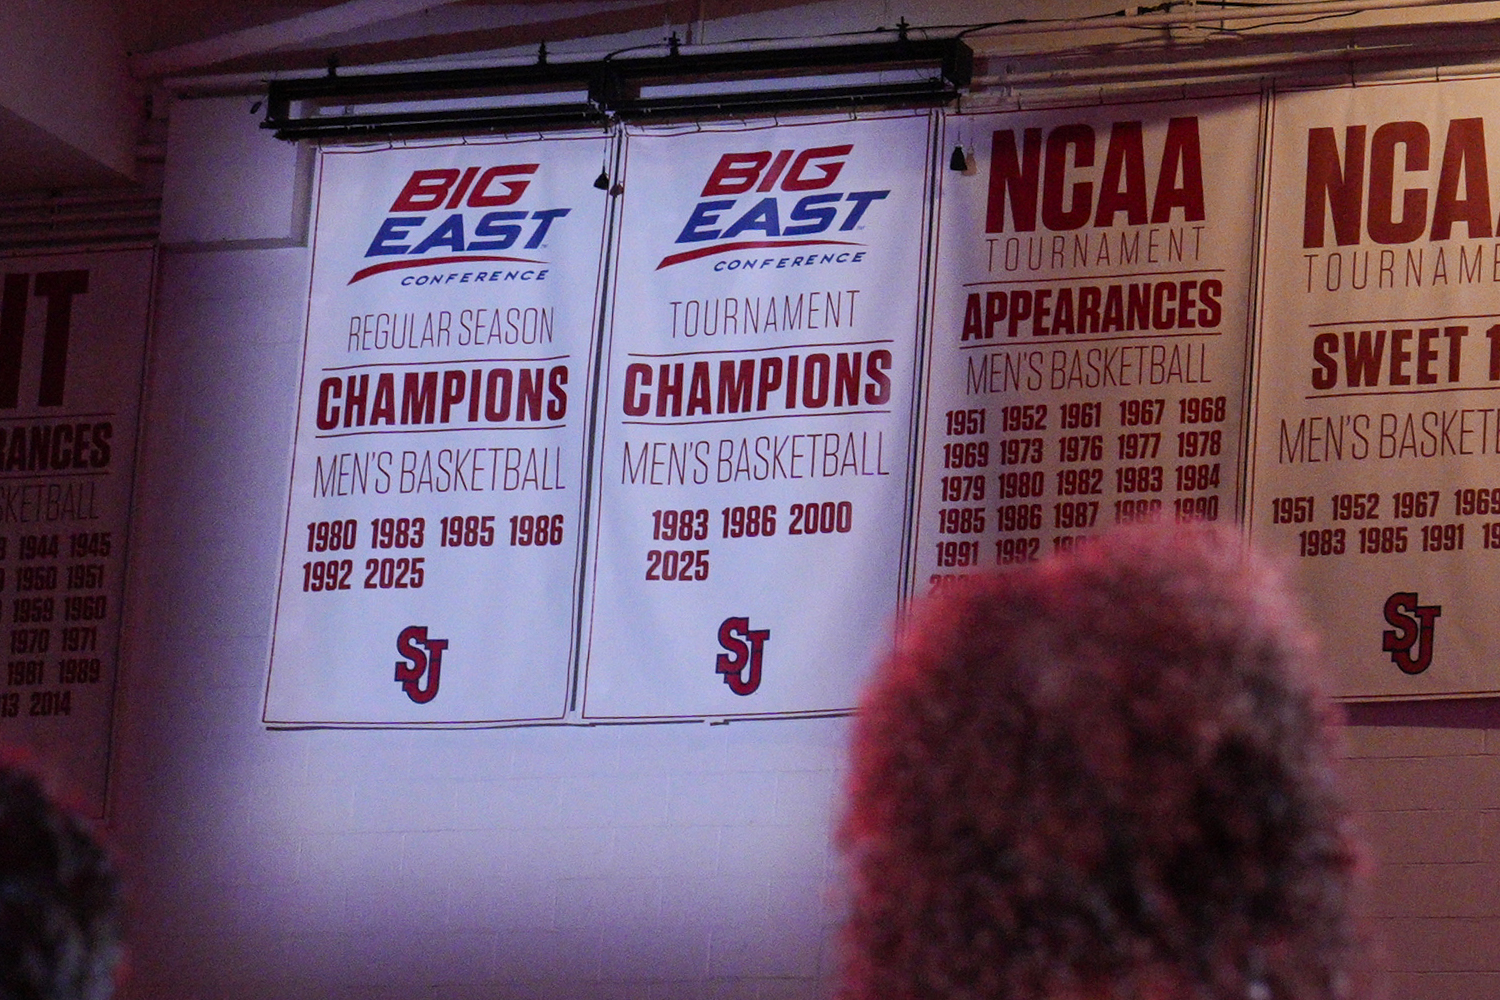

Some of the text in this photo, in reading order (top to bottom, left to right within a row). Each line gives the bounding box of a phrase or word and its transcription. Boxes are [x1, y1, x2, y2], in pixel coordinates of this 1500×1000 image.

[389, 163, 540, 213] BIG
[700, 144, 854, 197] BIG
[985, 116, 1205, 234] NCAA
[1303, 117, 1500, 248] NCA
[364, 208, 572, 258] EAST
[675, 190, 891, 243] EAST
[714, 252, 866, 271] CONFERENCE
[986, 226, 1205, 272] TOURNAMENT
[401, 269, 549, 286] CONFERENCE
[348, 306, 554, 353] REGULAR SEASON
[670, 290, 860, 338] TOURNAMENT
[961, 279, 1222, 341] APPEARANCES
[966, 343, 1211, 395] MEN'S BASKETBALL
[1311, 326, 1469, 390] SWEET
[316, 365, 569, 431] CHAMPIONS
[622, 350, 893, 417] CHAMPIONS
[945, 396, 1226, 436] 1951 1952 1961 1967 1968
[1279, 408, 1500, 464] MEN'S BASKET
[313, 446, 565, 498] MEN'S BASKETBALL
[621, 431, 889, 486] MEN'S BASKETBALL
[943, 430, 1222, 469] 1969 1973 1976 1977 1978
[940, 463, 1220, 503] 1979 1980 1982 1983 1984
[1272, 488, 1500, 524] 1951 1952 1967 1969
[307, 514, 564, 552] 1980 1983 1985 1986
[652, 502, 852, 542] 1983 1986 2000
[938, 507, 985, 534] 1985
[997, 504, 1042, 531] 1986
[1053, 501, 1099, 528] 1987
[1173, 496, 1218, 524] 1990
[19, 536, 58, 559] 1944
[70, 532, 111, 557] 1945
[936, 540, 979, 567] 1991
[995, 537, 1040, 565] 1992
[1299, 528, 1346, 557] 1983
[1359, 526, 1408, 554] 1985
[1421, 523, 1464, 552] 1991
[303, 558, 424, 592] 1992 2025
[646, 550, 709, 581] 2025
[10, 629, 50, 654] 1970
[62, 627, 96, 651] 1971
[29, 691, 71, 716] 2014
